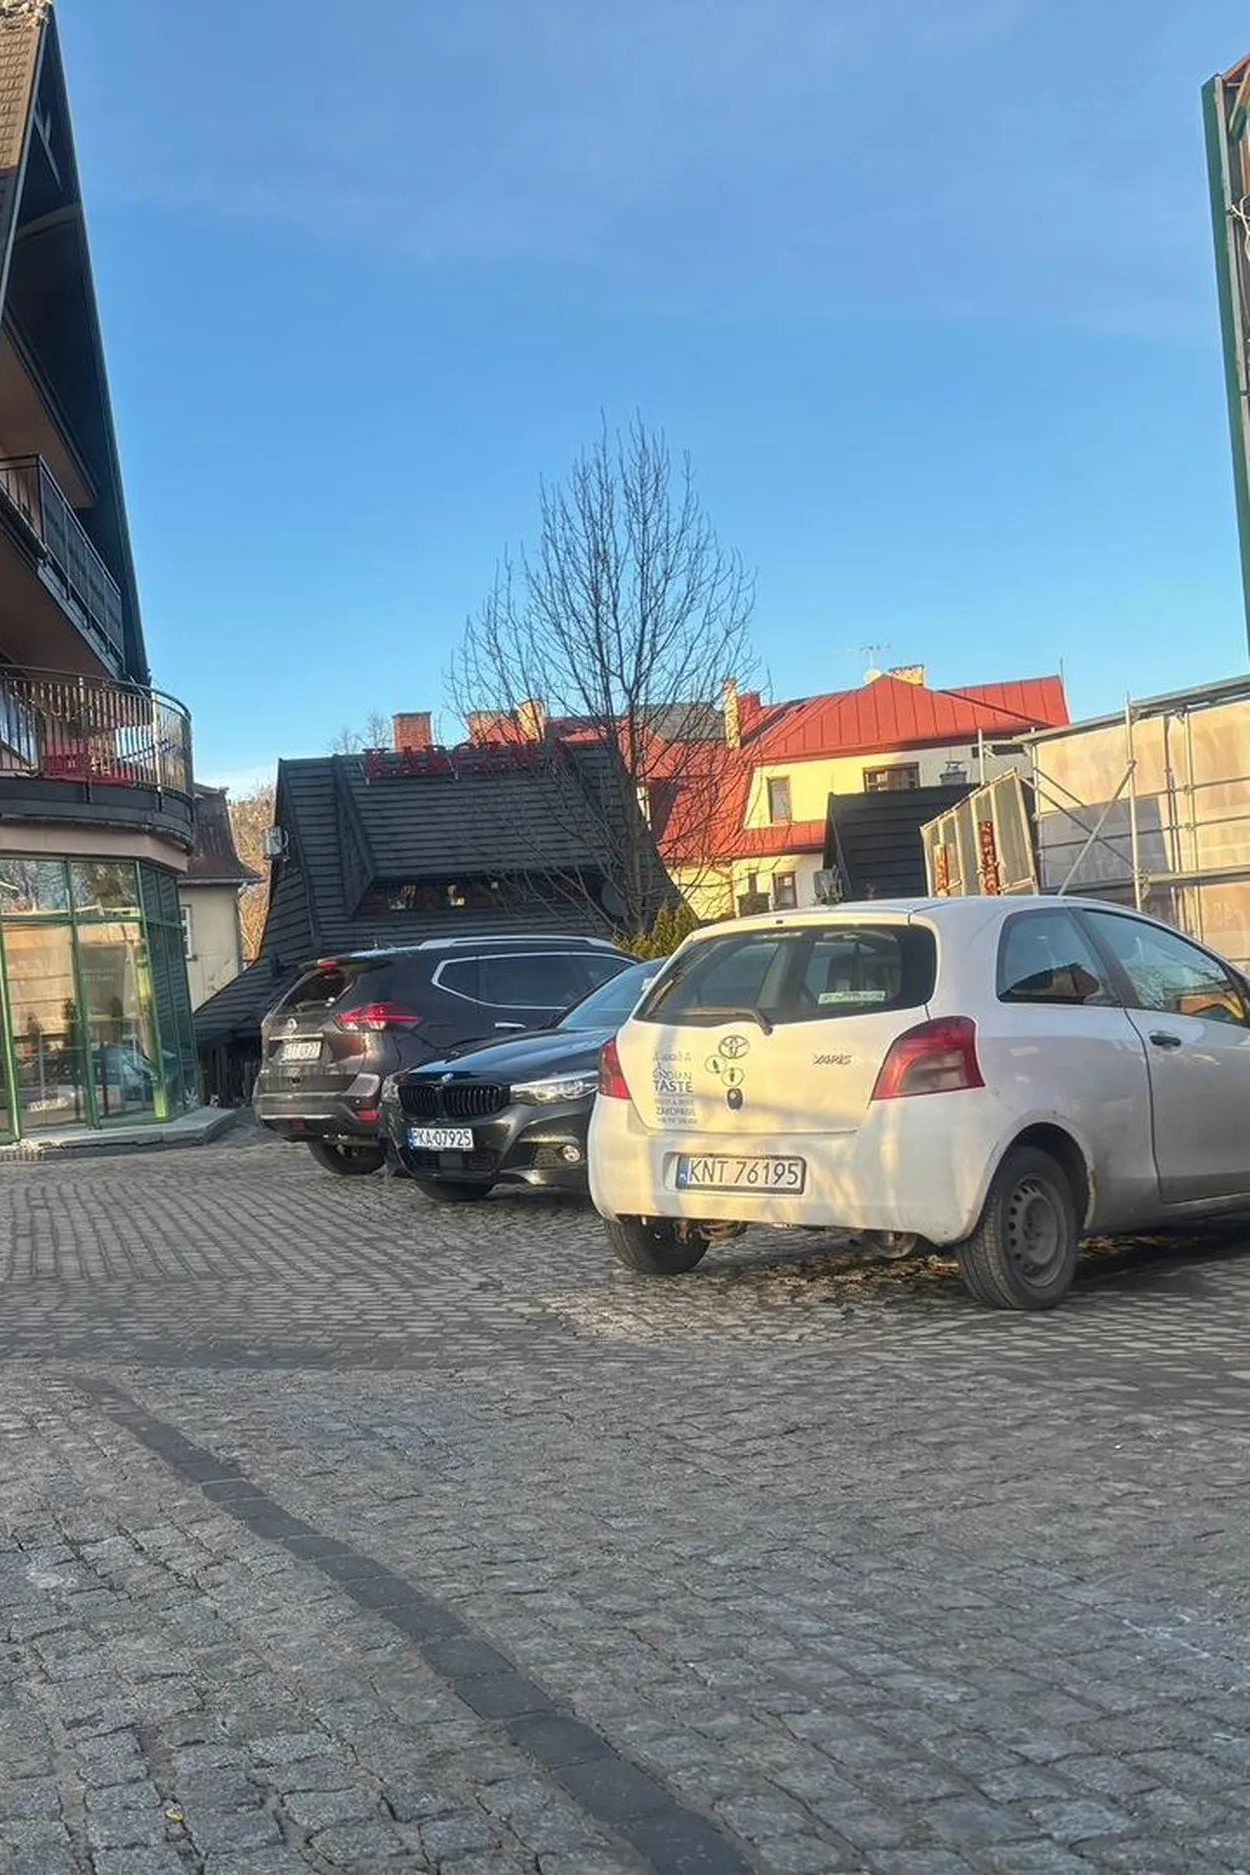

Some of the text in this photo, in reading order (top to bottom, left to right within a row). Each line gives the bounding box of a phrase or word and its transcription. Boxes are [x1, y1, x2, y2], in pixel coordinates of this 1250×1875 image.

[653, 1080, 694, 1093] TASTE
[689, 1160, 729, 1184] KNT
[733, 1162, 800, 1187] 76195
